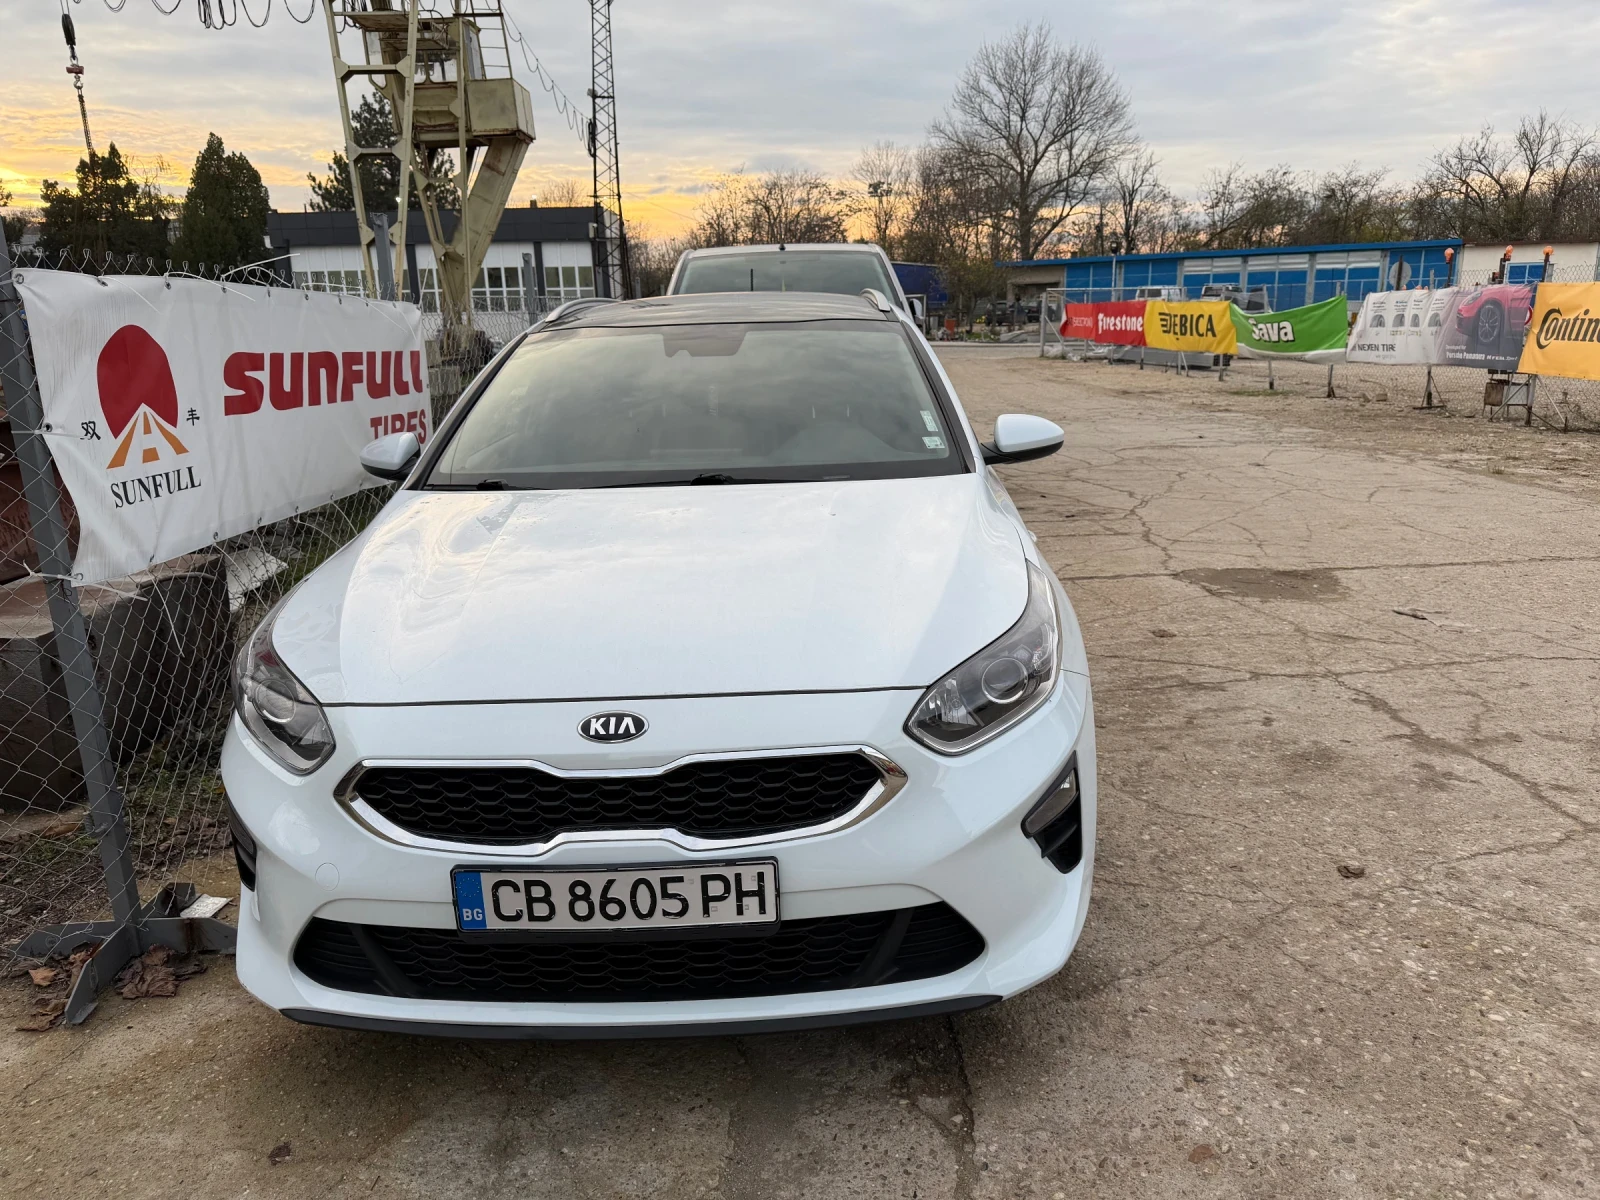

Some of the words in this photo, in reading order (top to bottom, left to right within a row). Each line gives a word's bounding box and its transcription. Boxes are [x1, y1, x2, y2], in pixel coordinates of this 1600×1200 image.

[1097, 313, 1144, 334] Firestone
[1248, 318, 1295, 342] Sava
[1536, 307, 1600, 349] Contin
[224, 350, 423, 416] SUNFULL
[80, 421, 101, 440] 双
[186, 407, 200, 426] 丰
[110, 466, 201, 509] SUNFULL
[589, 717, 636, 735] KIA
[491, 879, 556, 922] CB
[568, 876, 690, 921] 8605
[700, 871, 766, 918] PH
[462, 908, 483, 921] BG
